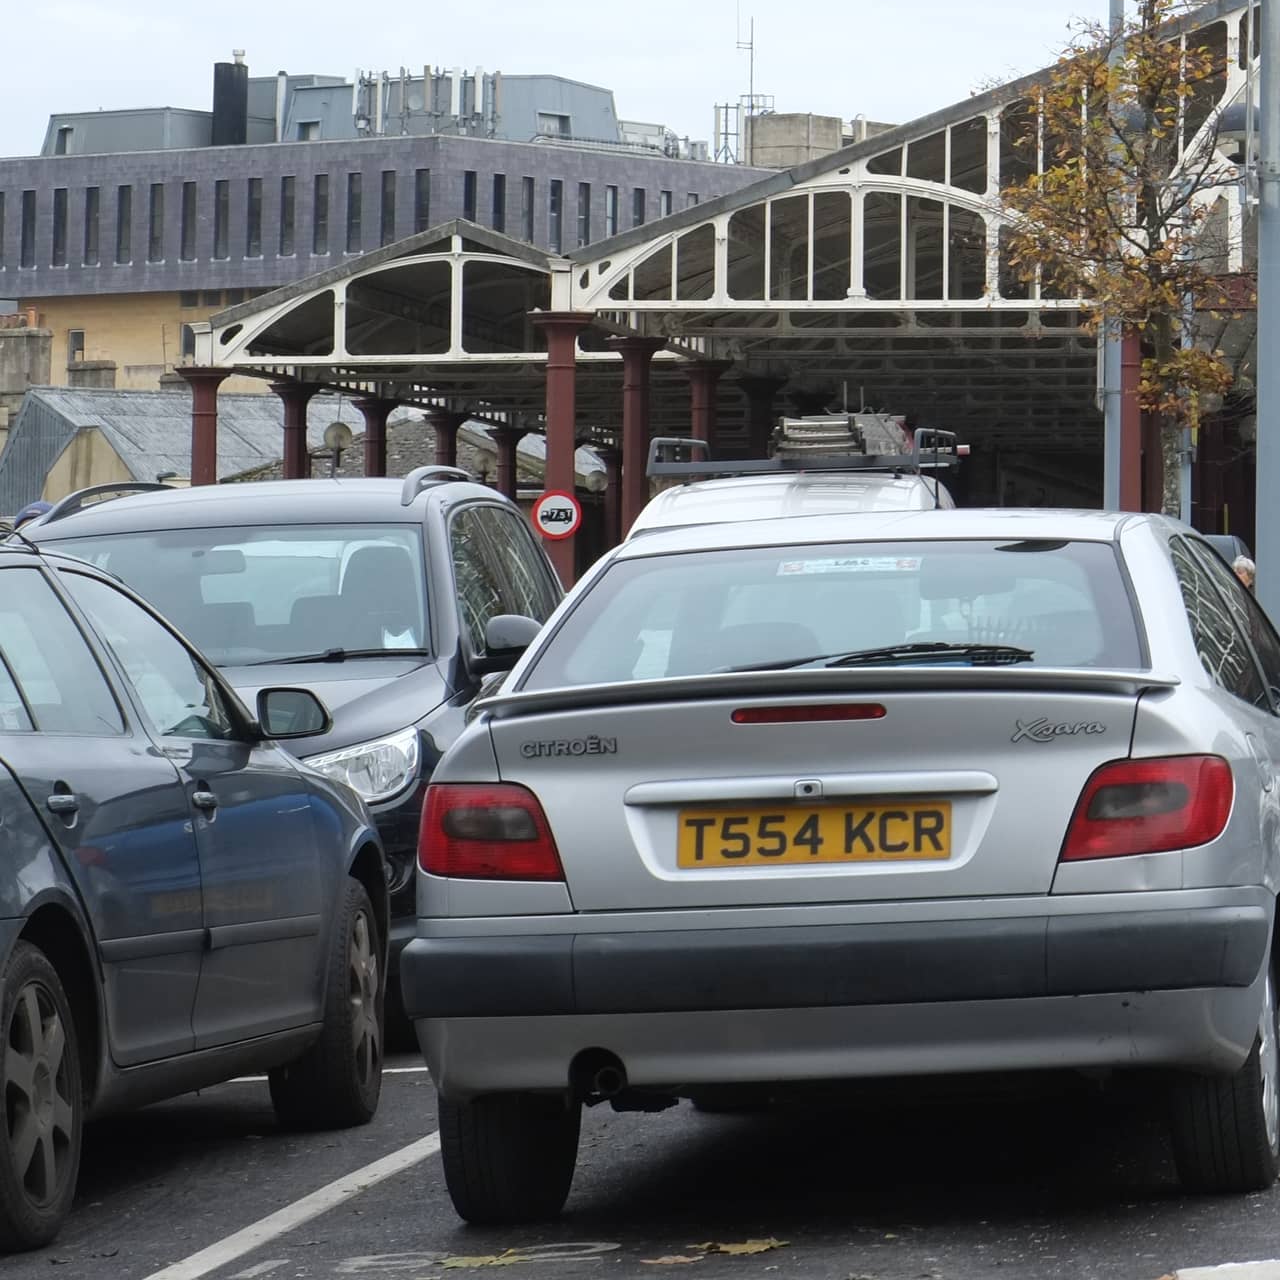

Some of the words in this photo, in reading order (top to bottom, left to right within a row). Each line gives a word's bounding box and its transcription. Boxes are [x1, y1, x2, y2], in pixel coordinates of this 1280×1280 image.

[1011, 717, 1106, 743] Xsara
[520, 734, 618, 759] CITROËN
[685, 813, 824, 861] T554
[844, 809, 945, 854] KCR
